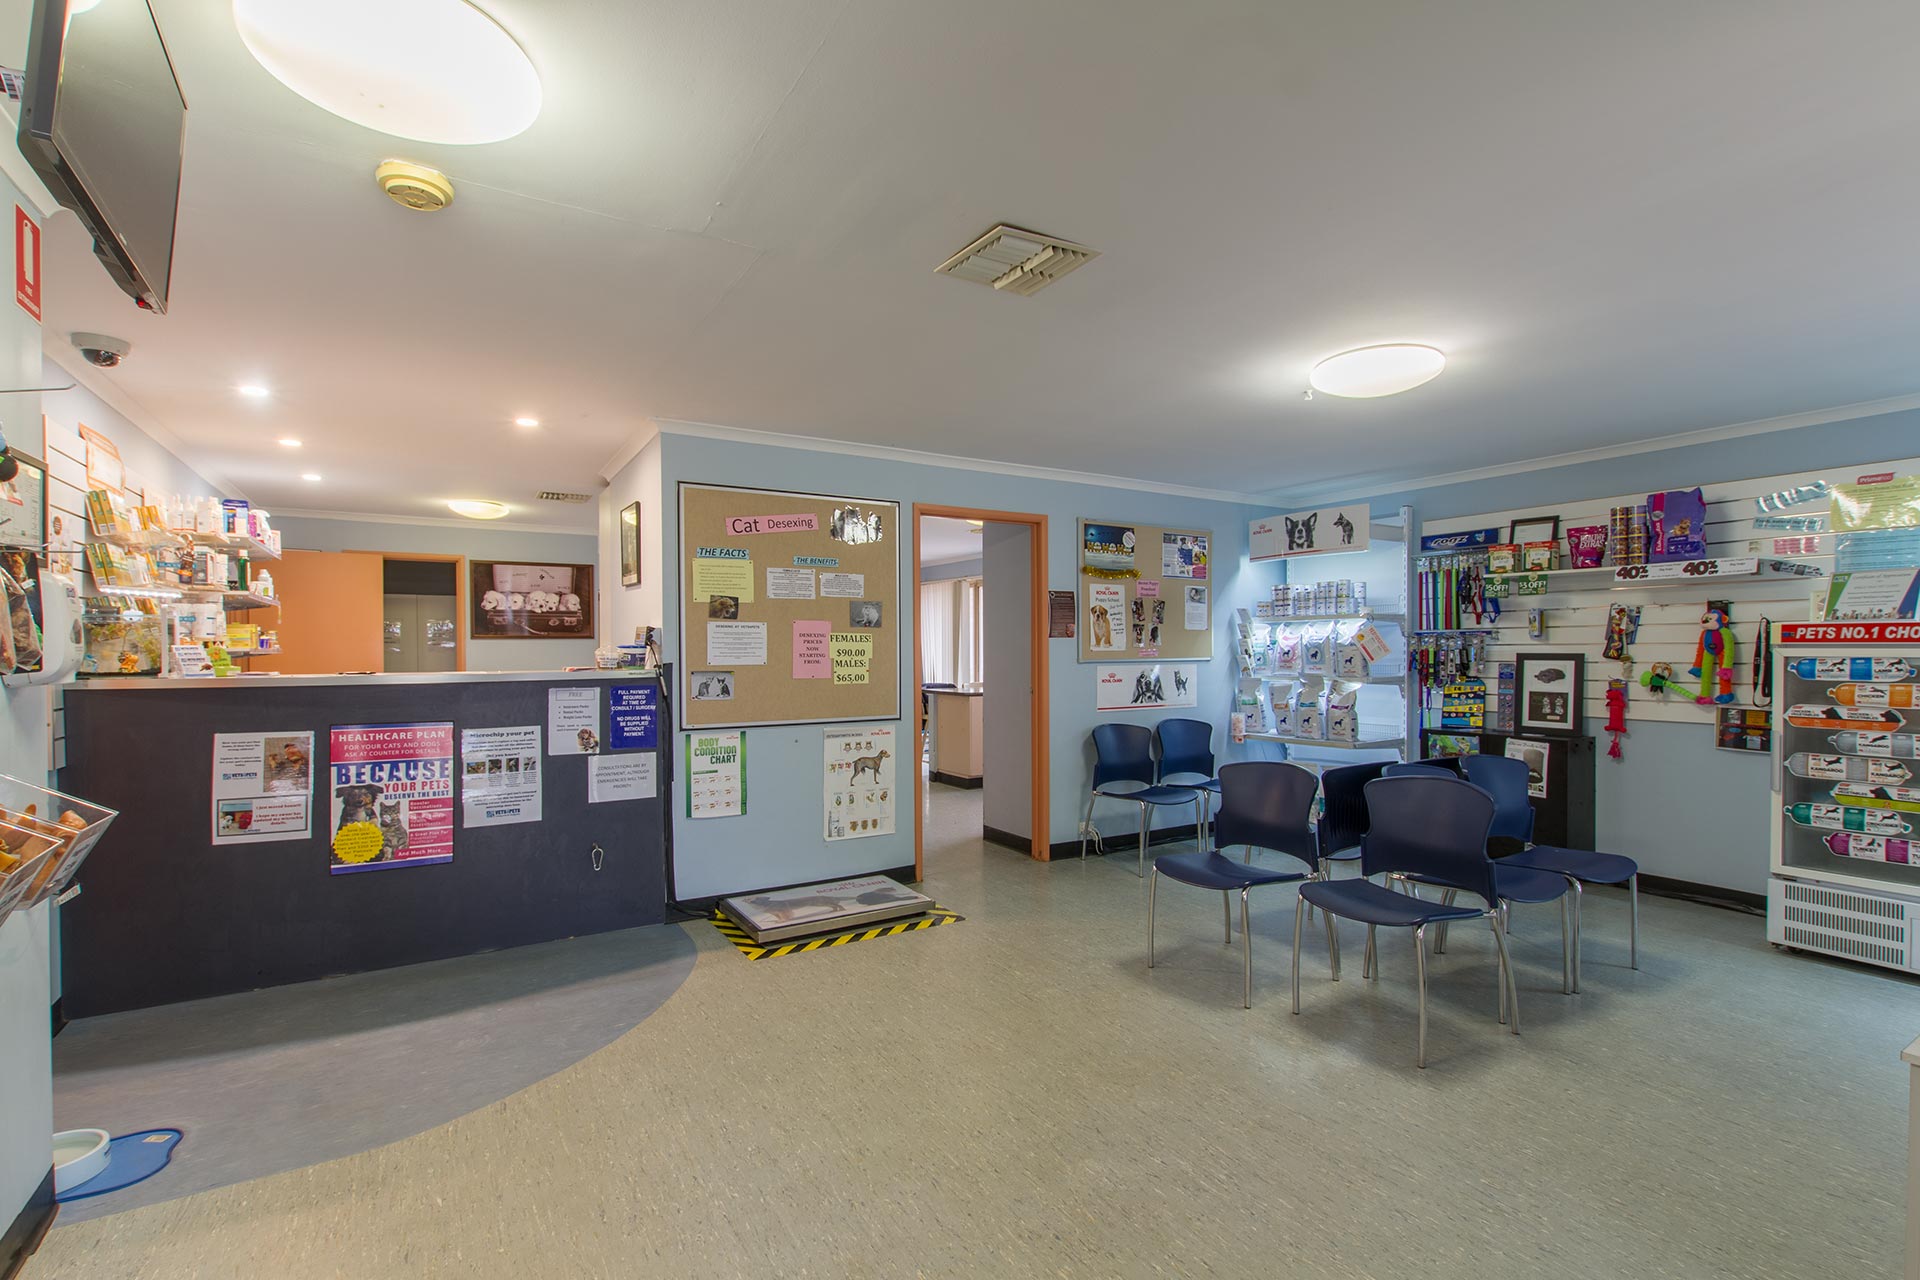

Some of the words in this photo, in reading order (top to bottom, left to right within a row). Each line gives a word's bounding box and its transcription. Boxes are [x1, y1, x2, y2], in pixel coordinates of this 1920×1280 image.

[732, 518, 760, 533] Cat
[768, 517, 814, 529] Desexing
[1430, 535, 1470, 547] rogz
[1580, 540, 1604, 548] EXTRAS
[699, 548, 717, 556] THE
[720, 548, 747, 557] FACTS
[809, 558, 838, 566] BENEFITS
[1796, 626, 1836, 639] PETS
[1840, 626, 1880, 639] NO.1
[1885, 625, 1920, 639] CHO
[830, 634, 872, 643] FEMALES:
[836, 648, 866, 657] $90.00
[836, 674, 865, 682] $65.00
[339, 731, 413, 742] HEALTHCARE
[416, 730, 445, 739] PLAN
[698, 737, 719, 748] BODY
[694, 745, 737, 757] CONDITION
[710, 754, 736, 764] CHART
[336, 760, 450, 785] BECAUSE
[384, 782, 417, 793] YOUR
[421, 780, 450, 791] PETS
